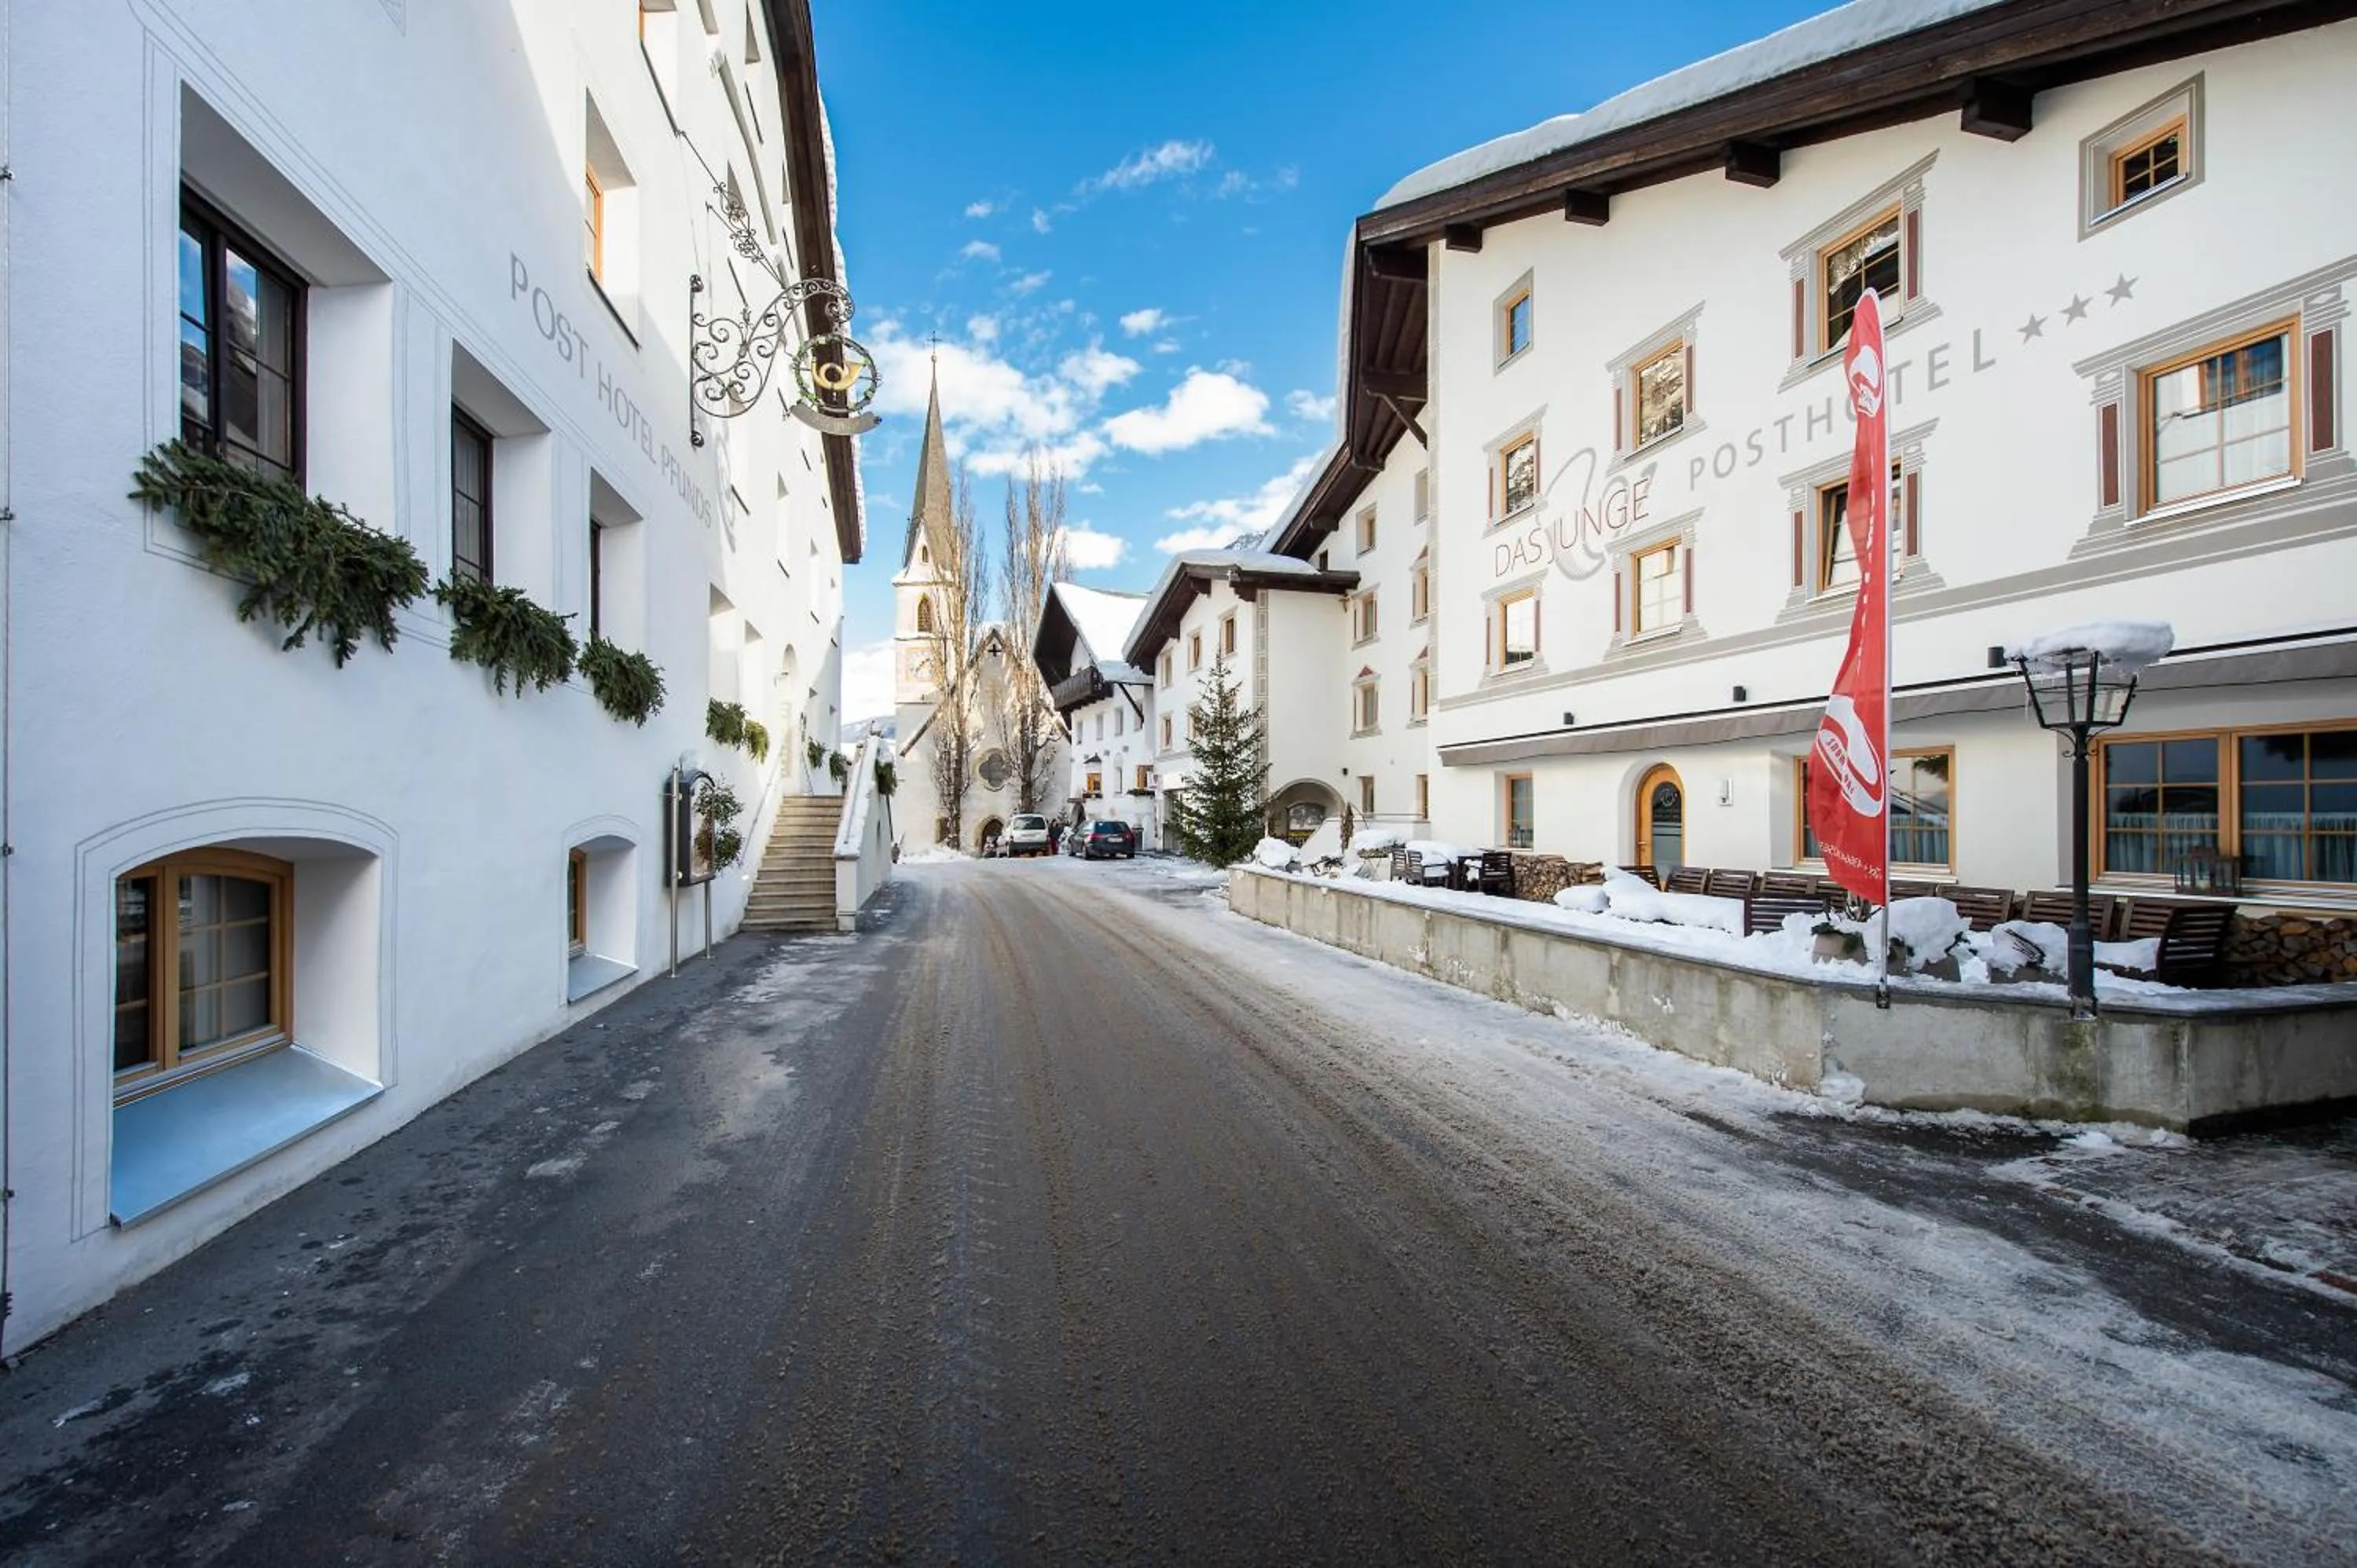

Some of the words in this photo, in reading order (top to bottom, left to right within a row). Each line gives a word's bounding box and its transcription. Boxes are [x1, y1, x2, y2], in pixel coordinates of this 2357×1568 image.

[511, 251, 589, 379] POST
[598, 361, 656, 464] HOTEL
[662, 444, 711, 528] PFUNDS
